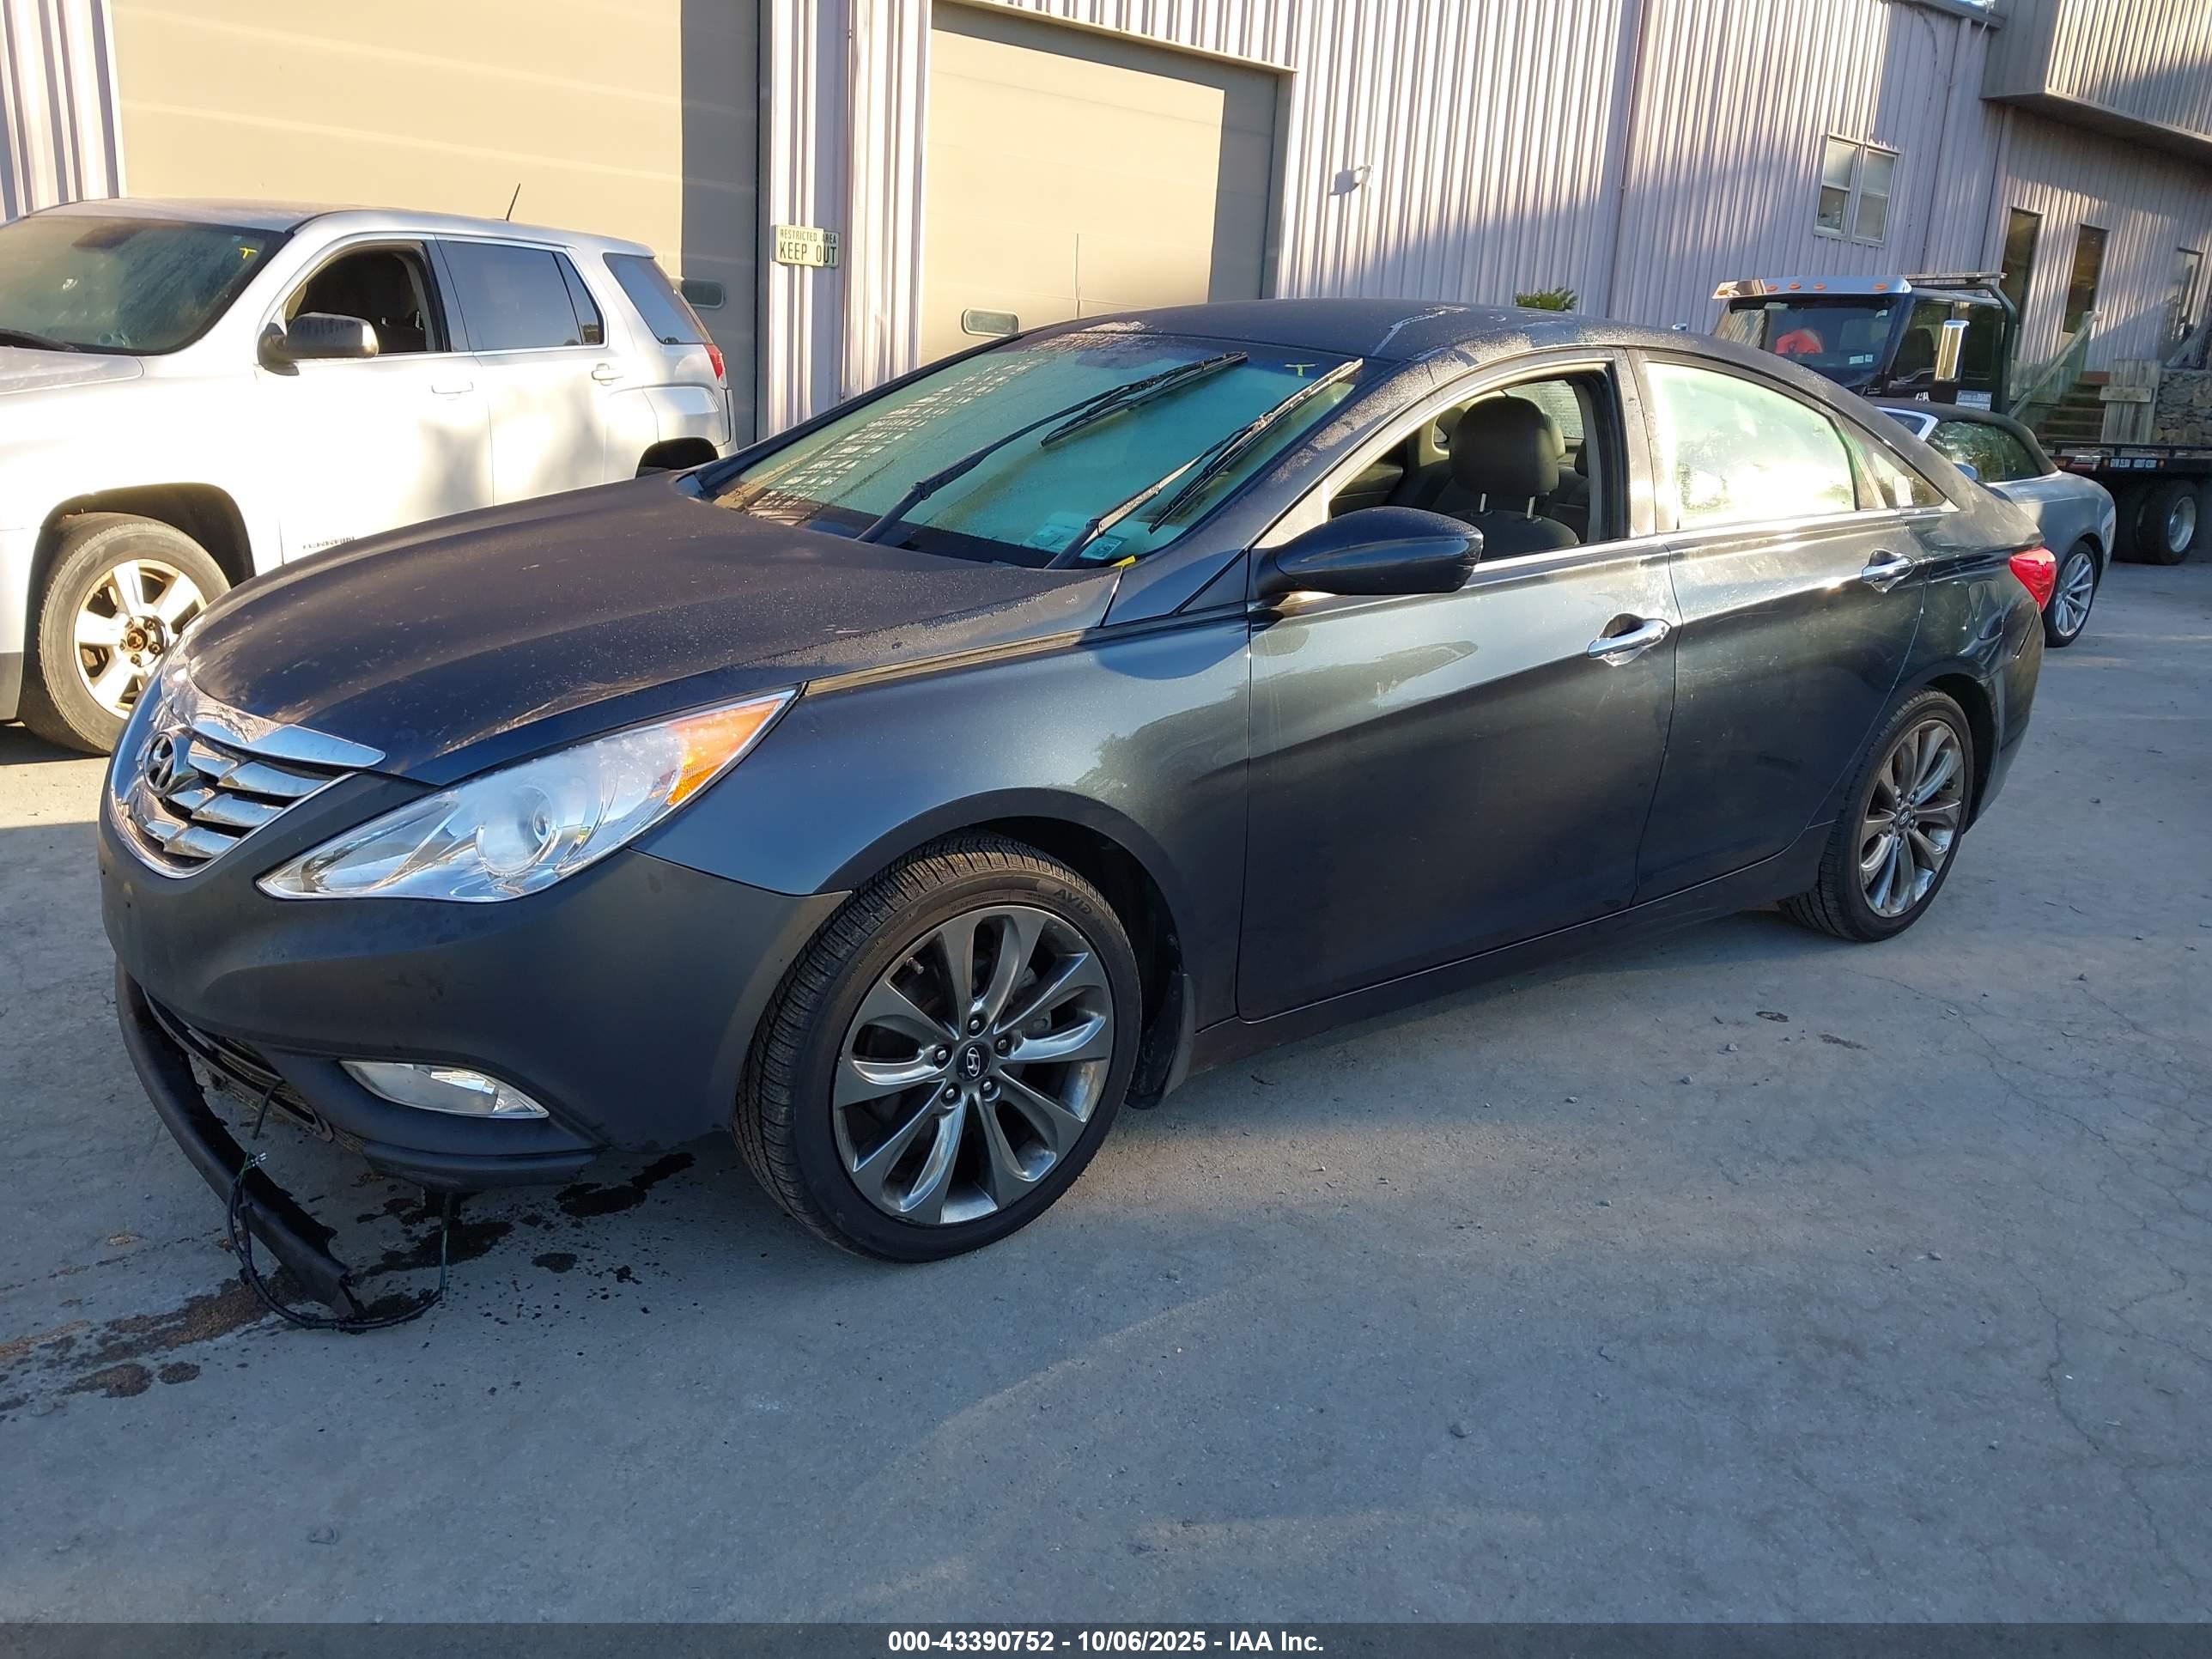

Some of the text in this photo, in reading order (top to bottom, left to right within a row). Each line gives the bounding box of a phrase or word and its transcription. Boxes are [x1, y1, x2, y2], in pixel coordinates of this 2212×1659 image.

[781, 229, 836, 244] RESTRICTED AREA
[780, 241, 837, 264] KEEP OUT
[1054, 888, 1093, 915] AVID
